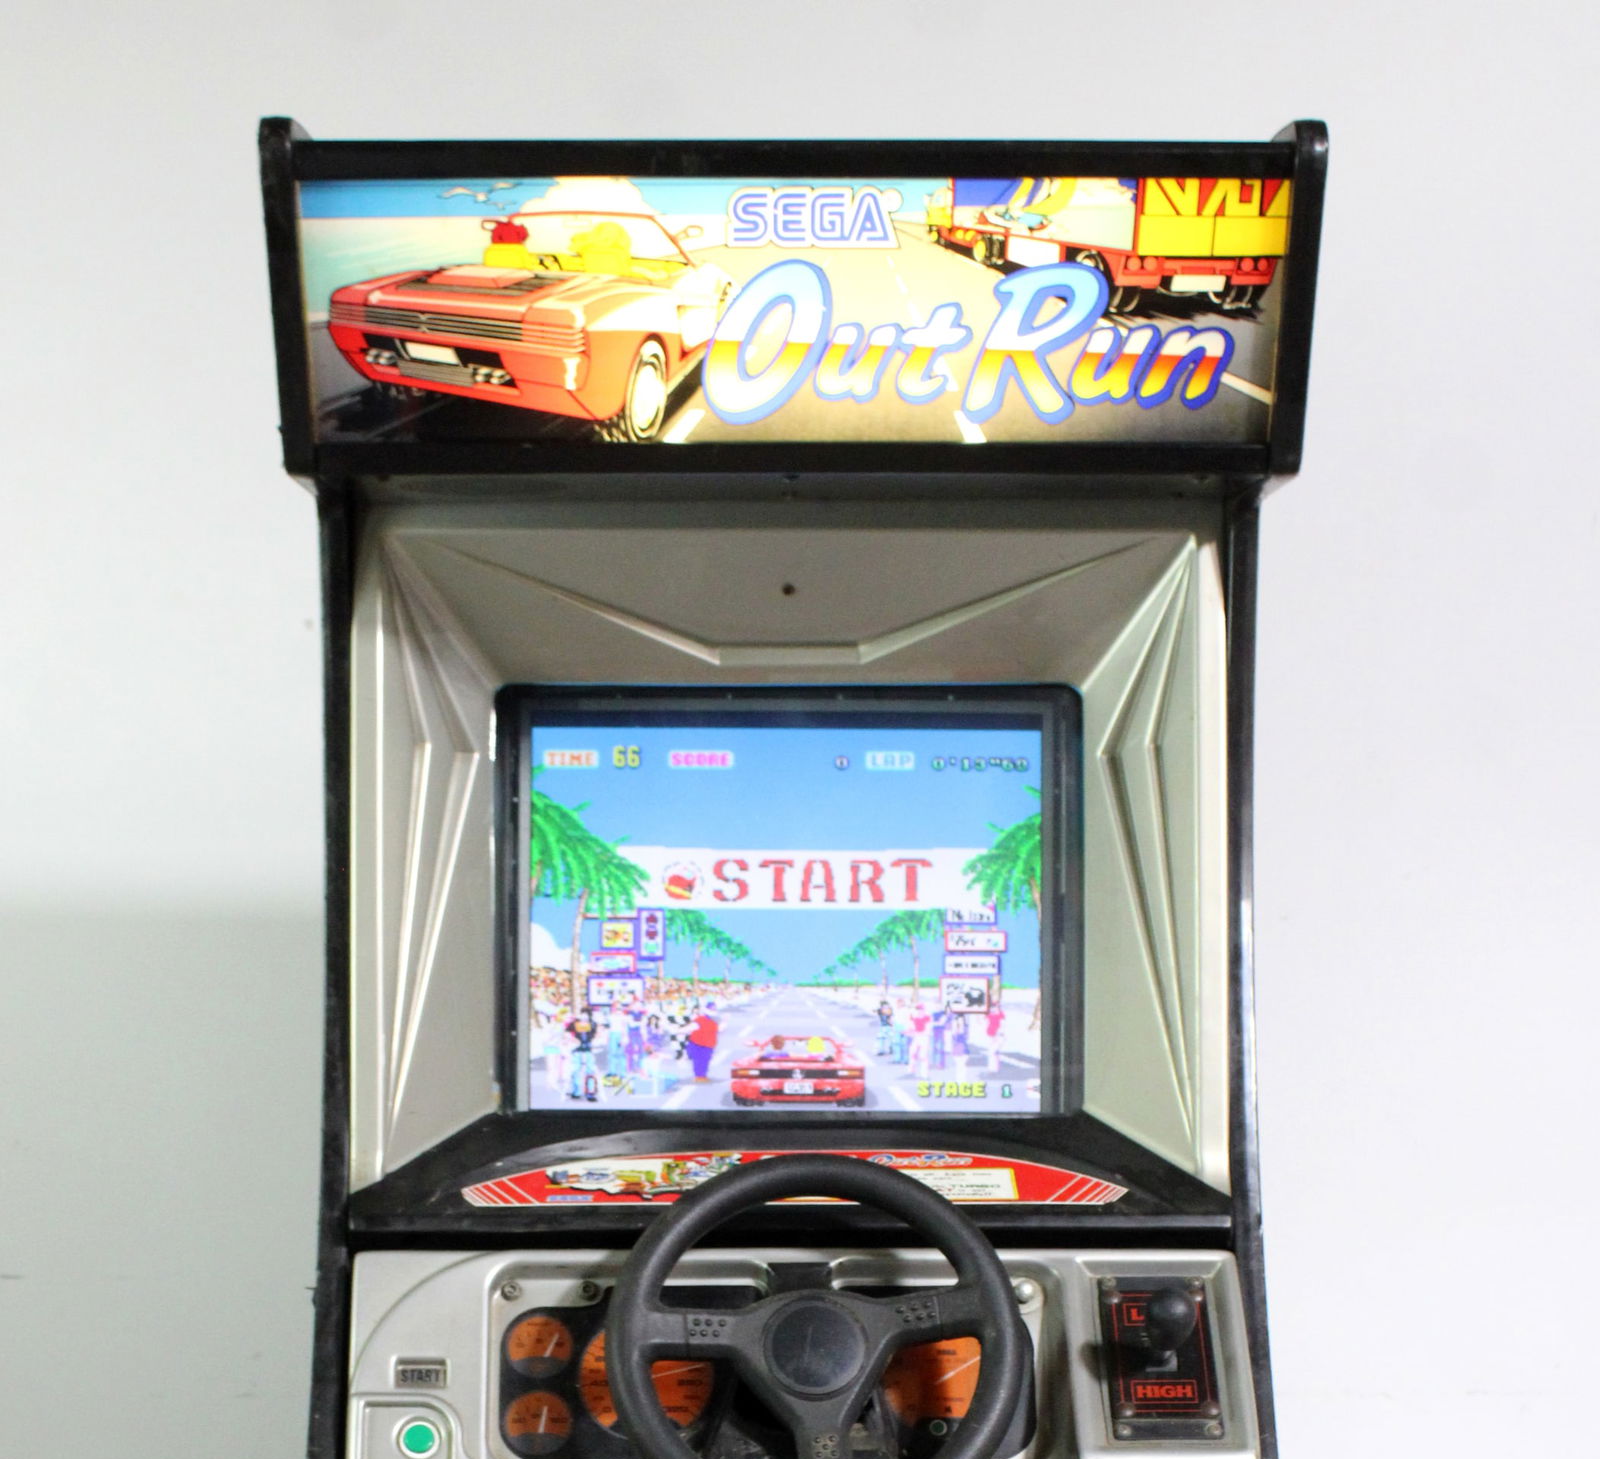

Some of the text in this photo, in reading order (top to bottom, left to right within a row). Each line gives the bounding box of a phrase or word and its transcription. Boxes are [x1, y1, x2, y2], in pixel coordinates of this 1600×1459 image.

[730, 190, 893, 244] SEGA
[545, 746, 640, 768] TIME 66
[671, 752, 730, 767] SCORE
[870, 752, 911, 768] LAP
[712, 858, 933, 902] START
[917, 1082, 1013, 1098] STAGE 1
[400, 1368, 441, 1383] START
[1136, 1385, 1193, 1399] HIGH
